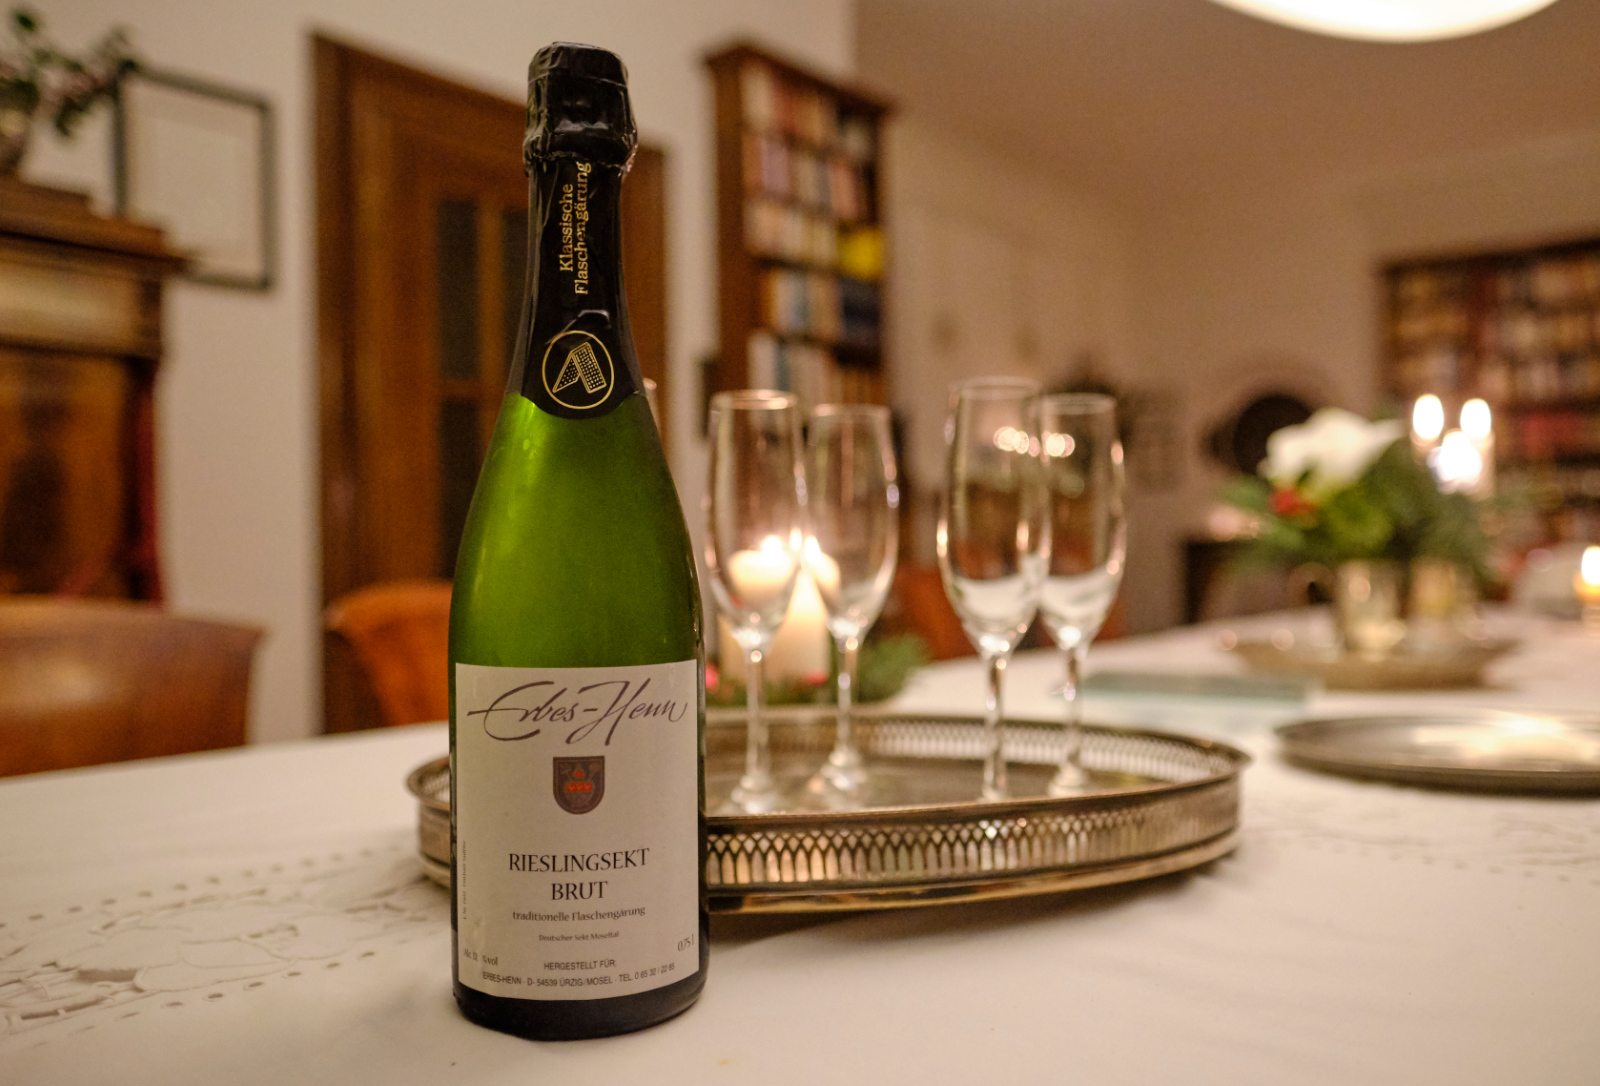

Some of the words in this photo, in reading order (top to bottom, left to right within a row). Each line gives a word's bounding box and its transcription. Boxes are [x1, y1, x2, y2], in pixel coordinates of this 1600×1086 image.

[559, 183, 573, 272] Klassische
[574, 161, 591, 295] Flaschengärung
[467, 678, 687, 746] Erbes-Henn
[509, 847, 650, 873] RIESLINGSEKT
[551, 880, 608, 901] BRUT
[512, 911, 570, 922] traditionelle
[538, 934, 573, 942] Deutscher
[590, 930, 620, 940] Moseltal
[543, 961, 598, 971] HERGESTELLT
[482, 971, 522, 985] ERBES-HENN
[536, 978, 558, 987] 54539
